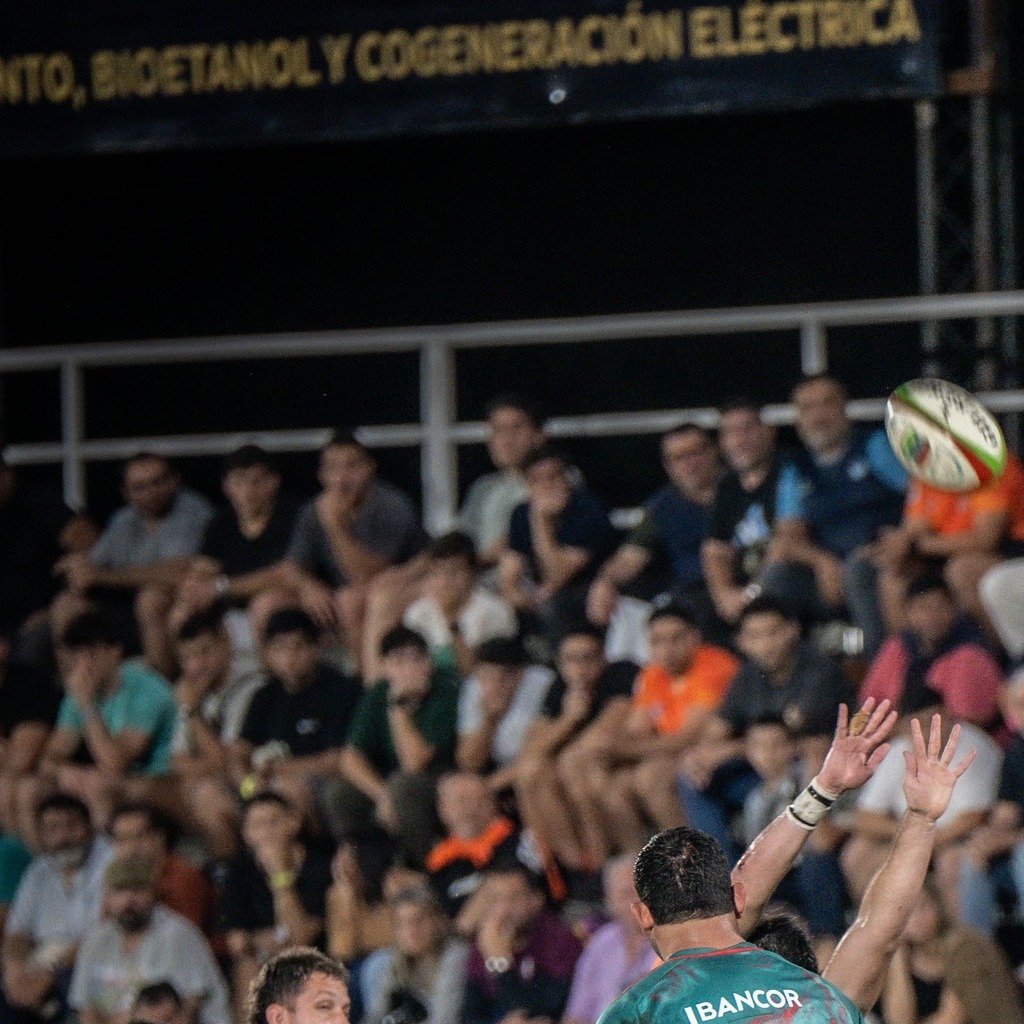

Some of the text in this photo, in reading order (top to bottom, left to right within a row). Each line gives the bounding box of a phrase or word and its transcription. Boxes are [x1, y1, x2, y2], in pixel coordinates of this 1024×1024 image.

[91, 39, 322, 100] BIOETANOL
[318, 34, 352, 84] Y
[355, 1, 683, 83] COGENERACIÓN
[696, 989, 803, 1022] BANCOR
